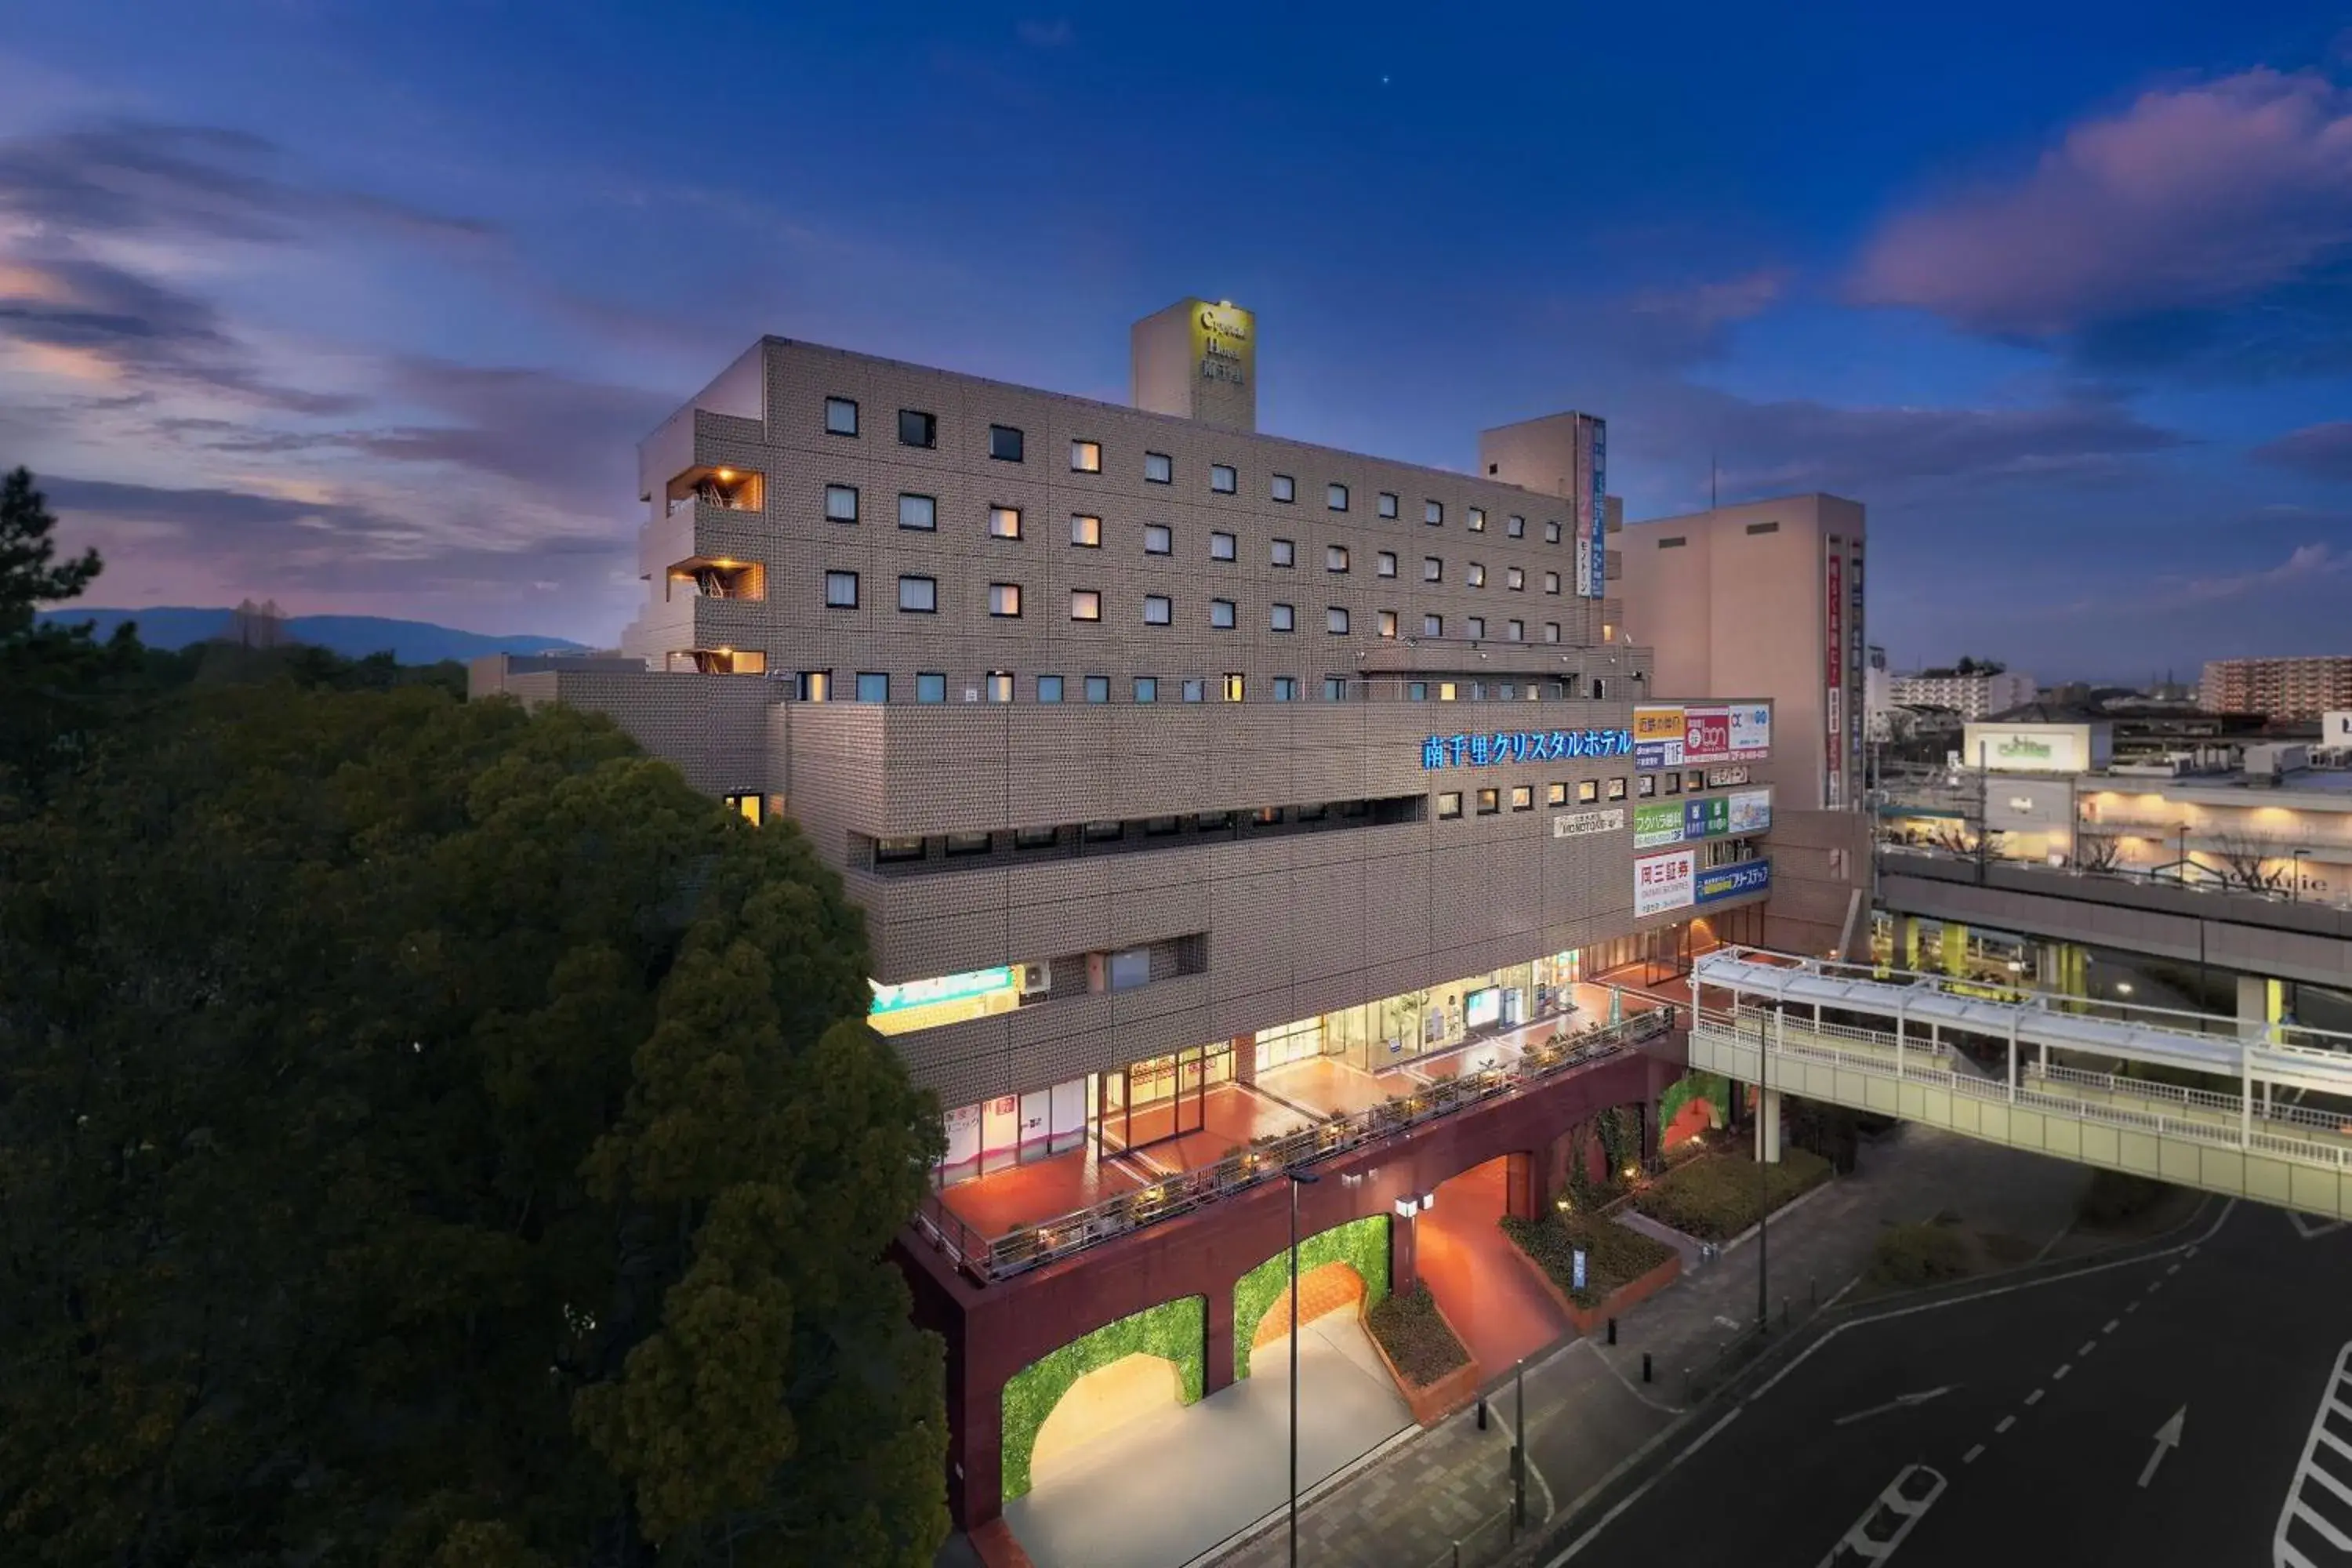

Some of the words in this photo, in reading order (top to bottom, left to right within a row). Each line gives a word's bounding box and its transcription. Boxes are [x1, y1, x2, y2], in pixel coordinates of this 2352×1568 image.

[1423, 729, 1633, 770] 南千里クリスタルホテル
[1641, 860, 1689, 887] 岡三証券
